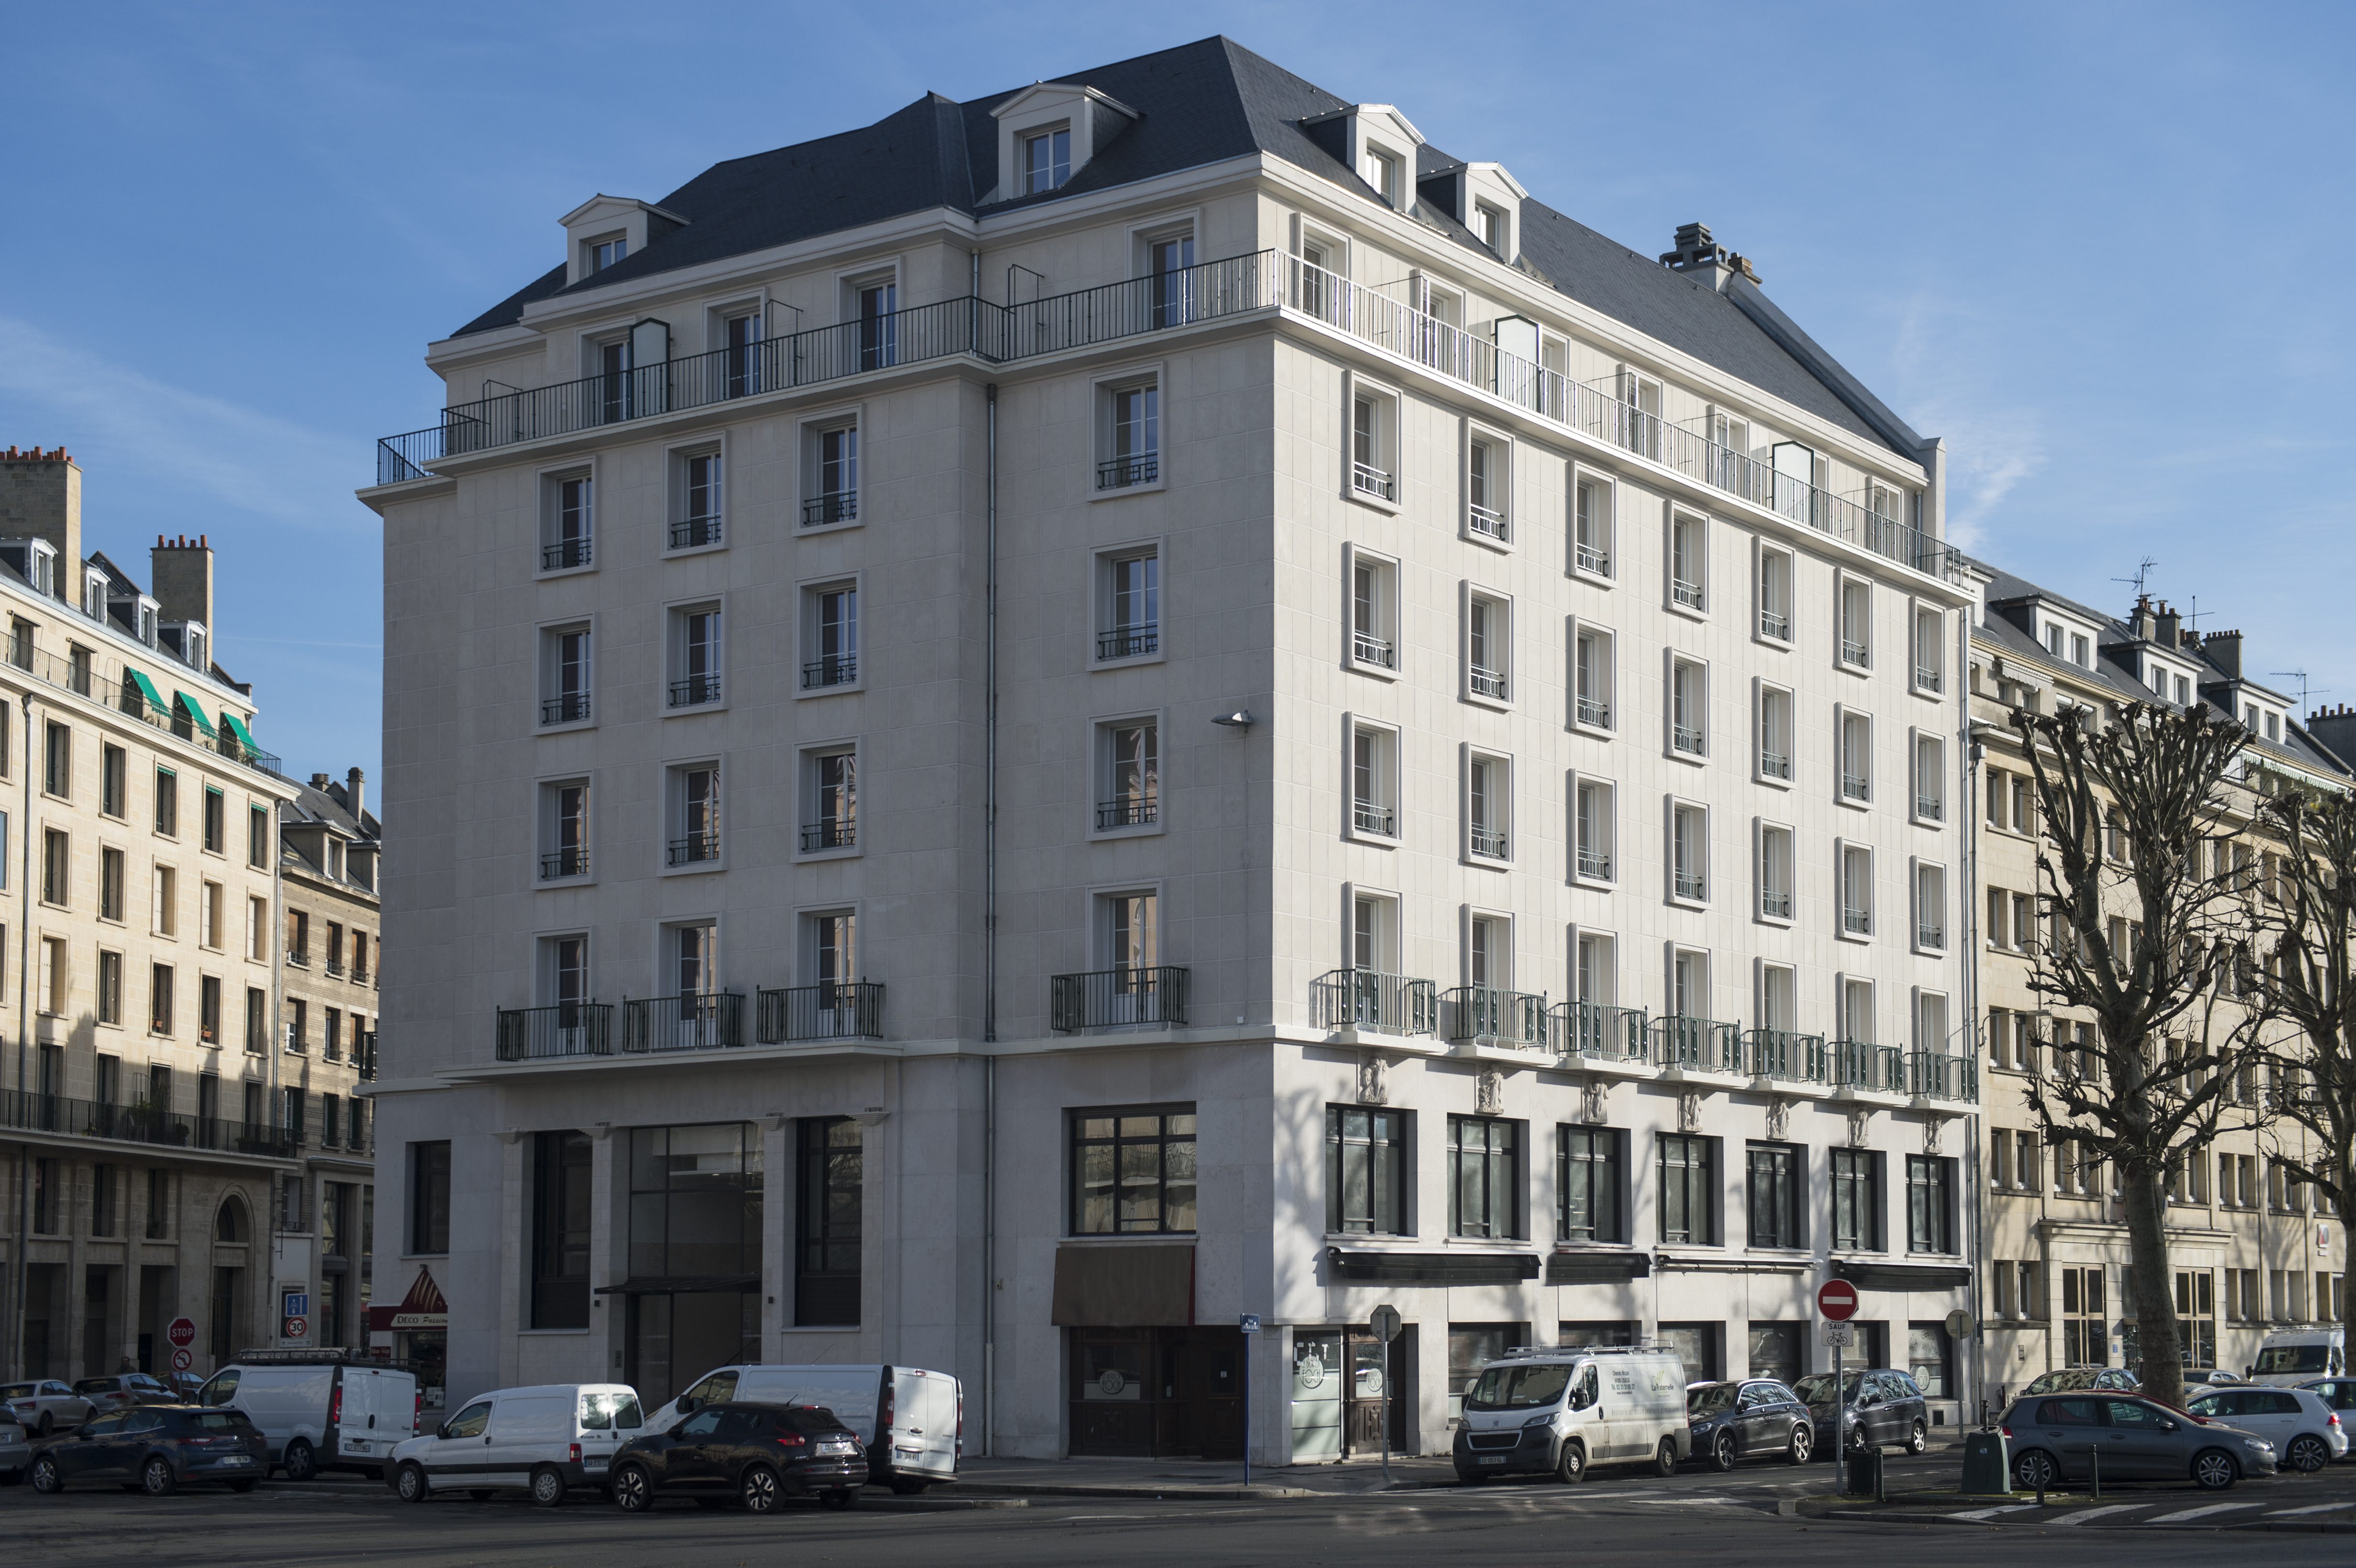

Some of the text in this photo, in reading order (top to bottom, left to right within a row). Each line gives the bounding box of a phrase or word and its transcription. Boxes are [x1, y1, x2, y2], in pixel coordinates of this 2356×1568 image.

[397, 1316, 418, 1324] DÉCO
[291, 1323, 304, 1331] 30
[172, 1328, 193, 1337] STOP
[1302, 1369, 1320, 1383] FOCH
[1102, 1380, 1121, 1391] FOCH
[1368, 1378, 1381, 1388] FOCH
